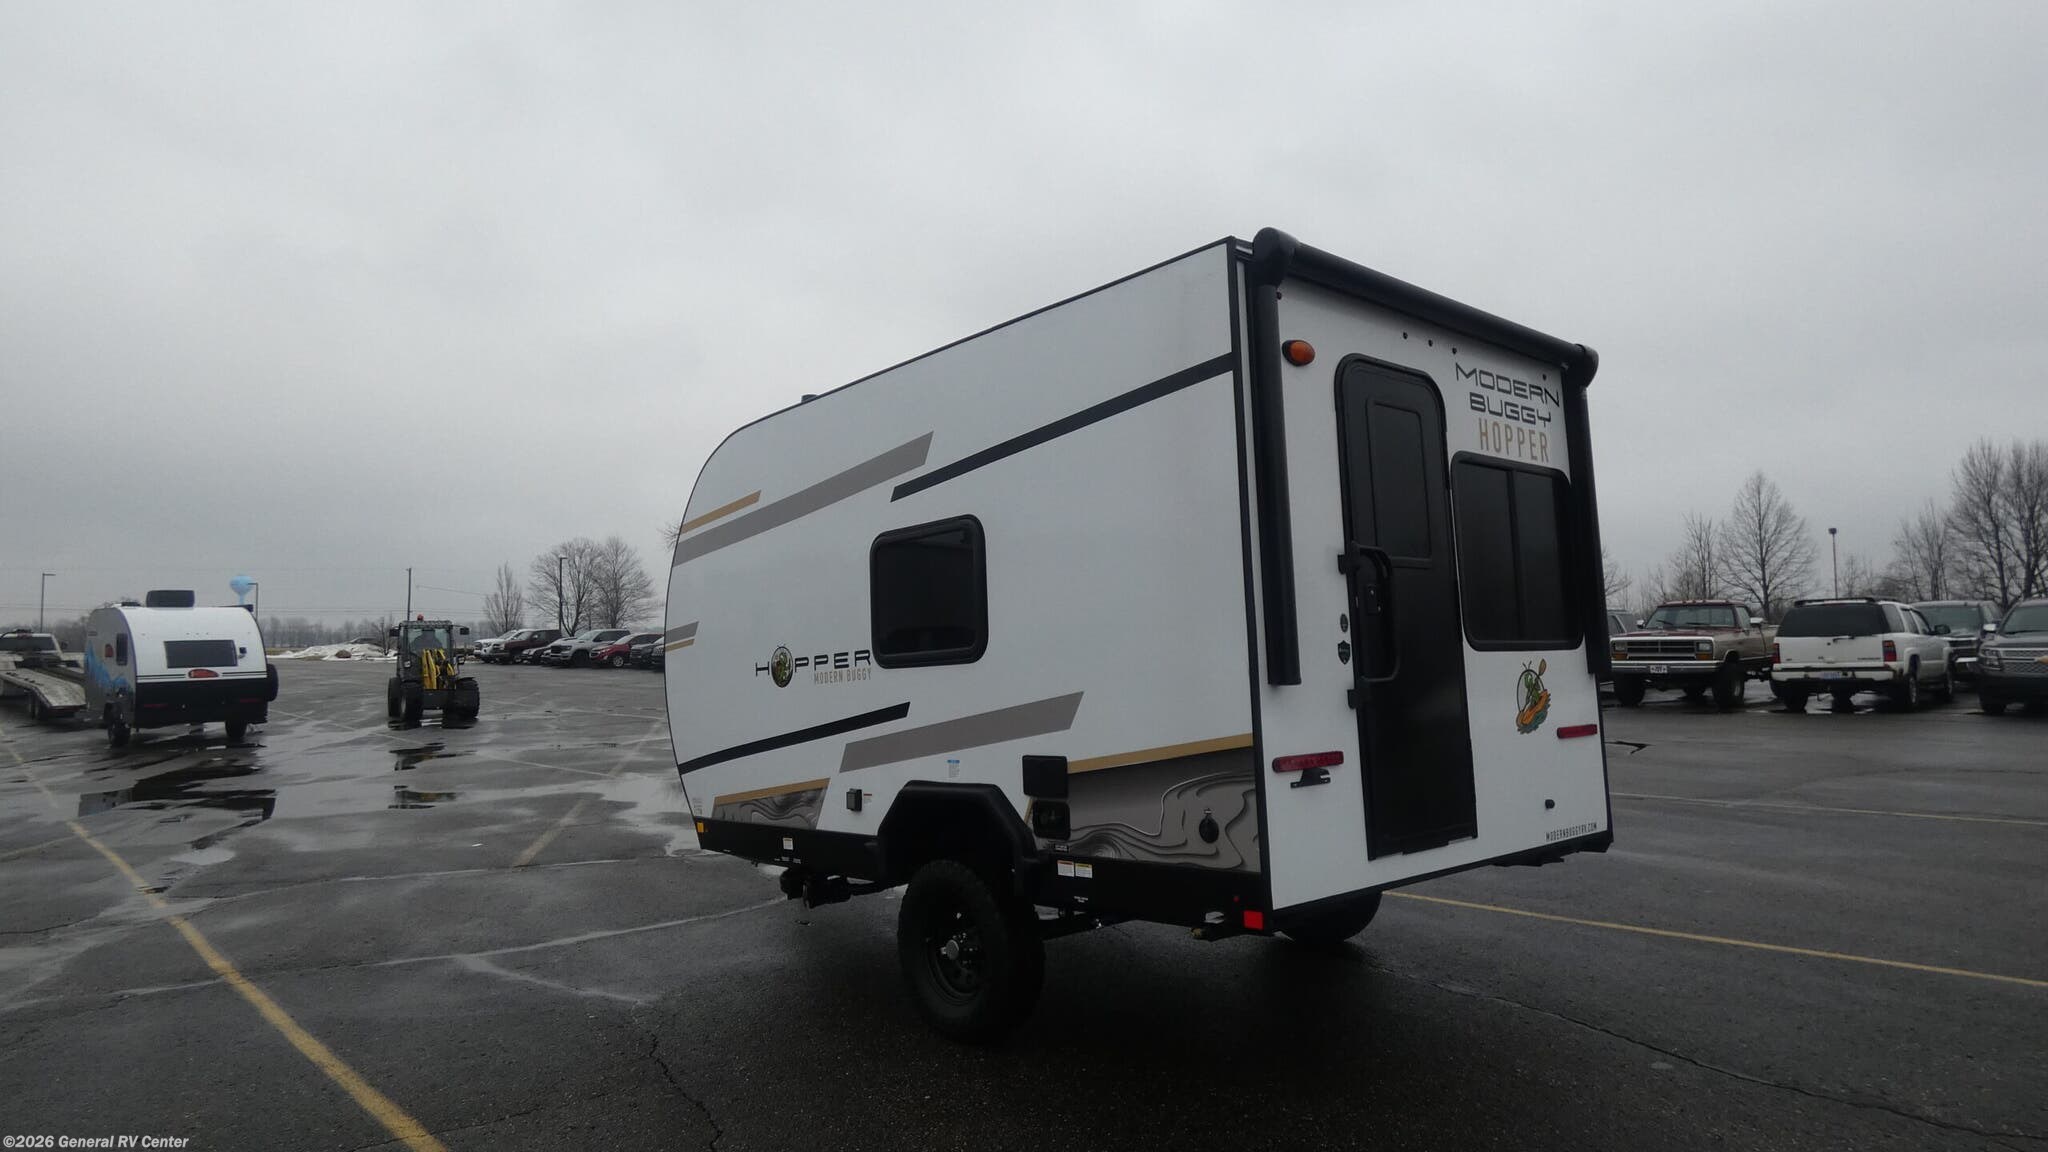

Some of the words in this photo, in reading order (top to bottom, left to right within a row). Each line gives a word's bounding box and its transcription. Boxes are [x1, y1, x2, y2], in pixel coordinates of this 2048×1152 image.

[1455, 362, 1559, 407] MODERN
[1469, 392, 1551, 428] BUGGY
[1479, 417, 1549, 463] HOPPER
[814, 670, 843, 685] MODERN
[847, 668, 872, 682] BUGGY
